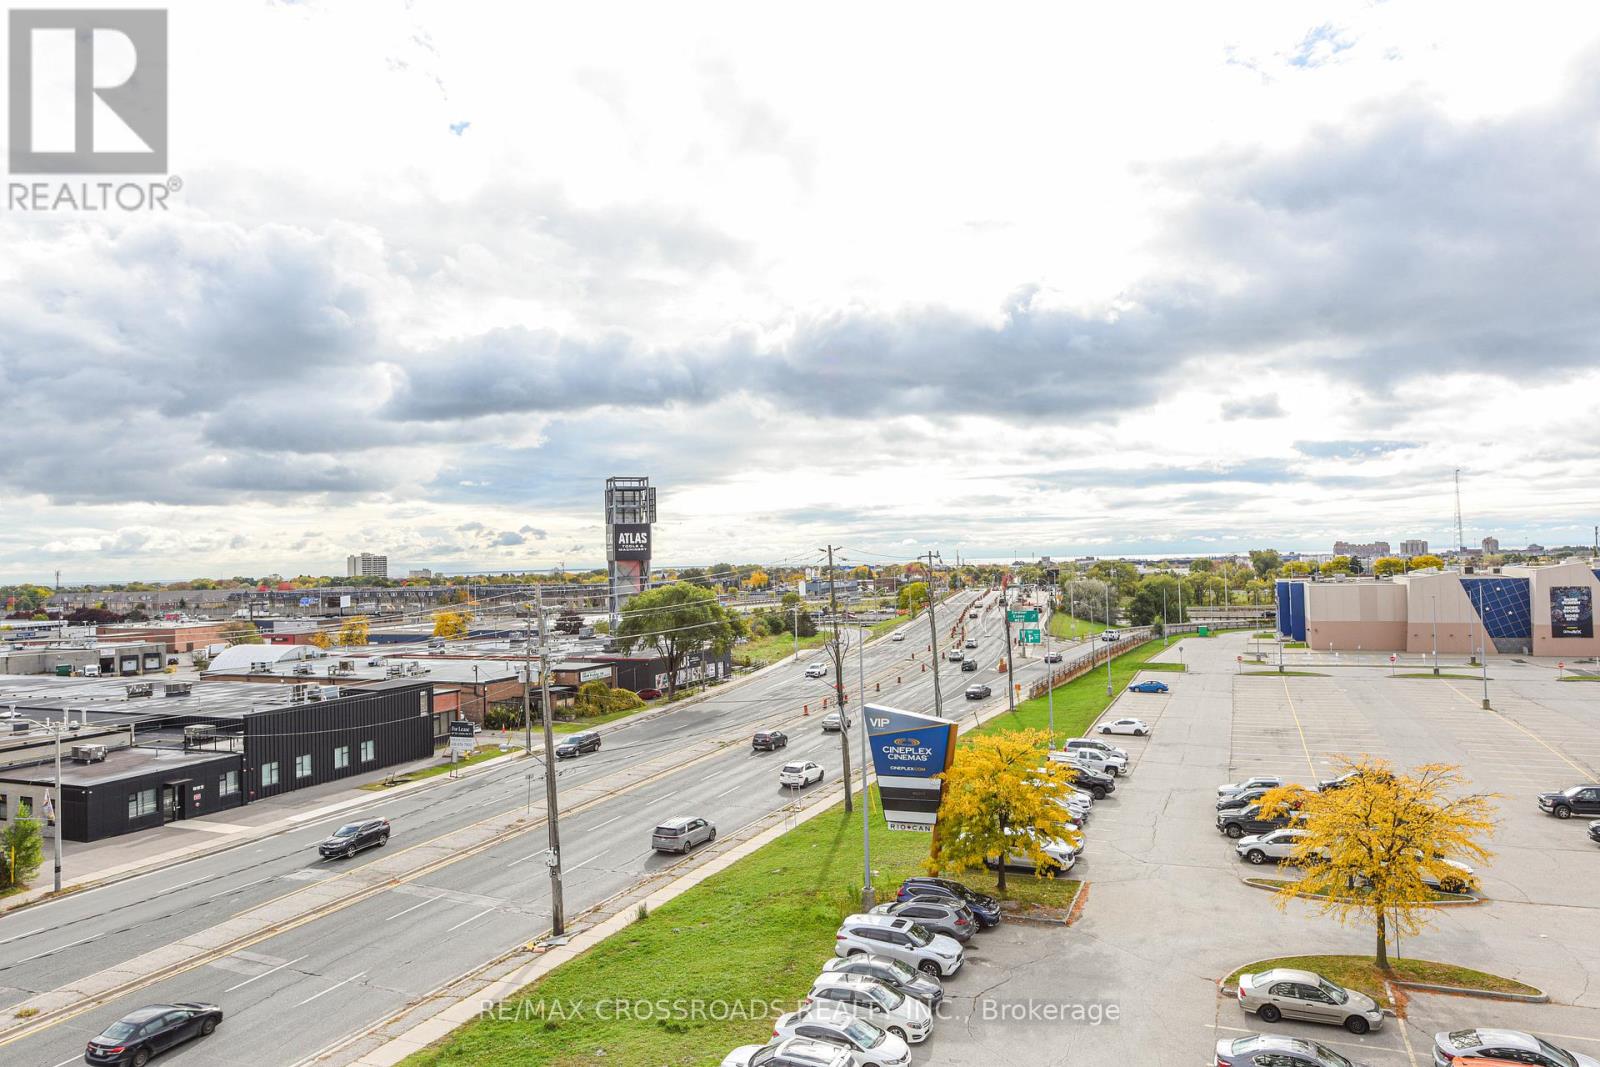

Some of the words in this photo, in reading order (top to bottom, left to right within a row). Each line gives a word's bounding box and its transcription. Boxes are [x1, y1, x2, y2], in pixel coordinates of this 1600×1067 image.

[619, 532, 647, 544] ATLAS
[869, 718, 890, 728] VIP
[882, 746, 932, 755] CINEPLEX
